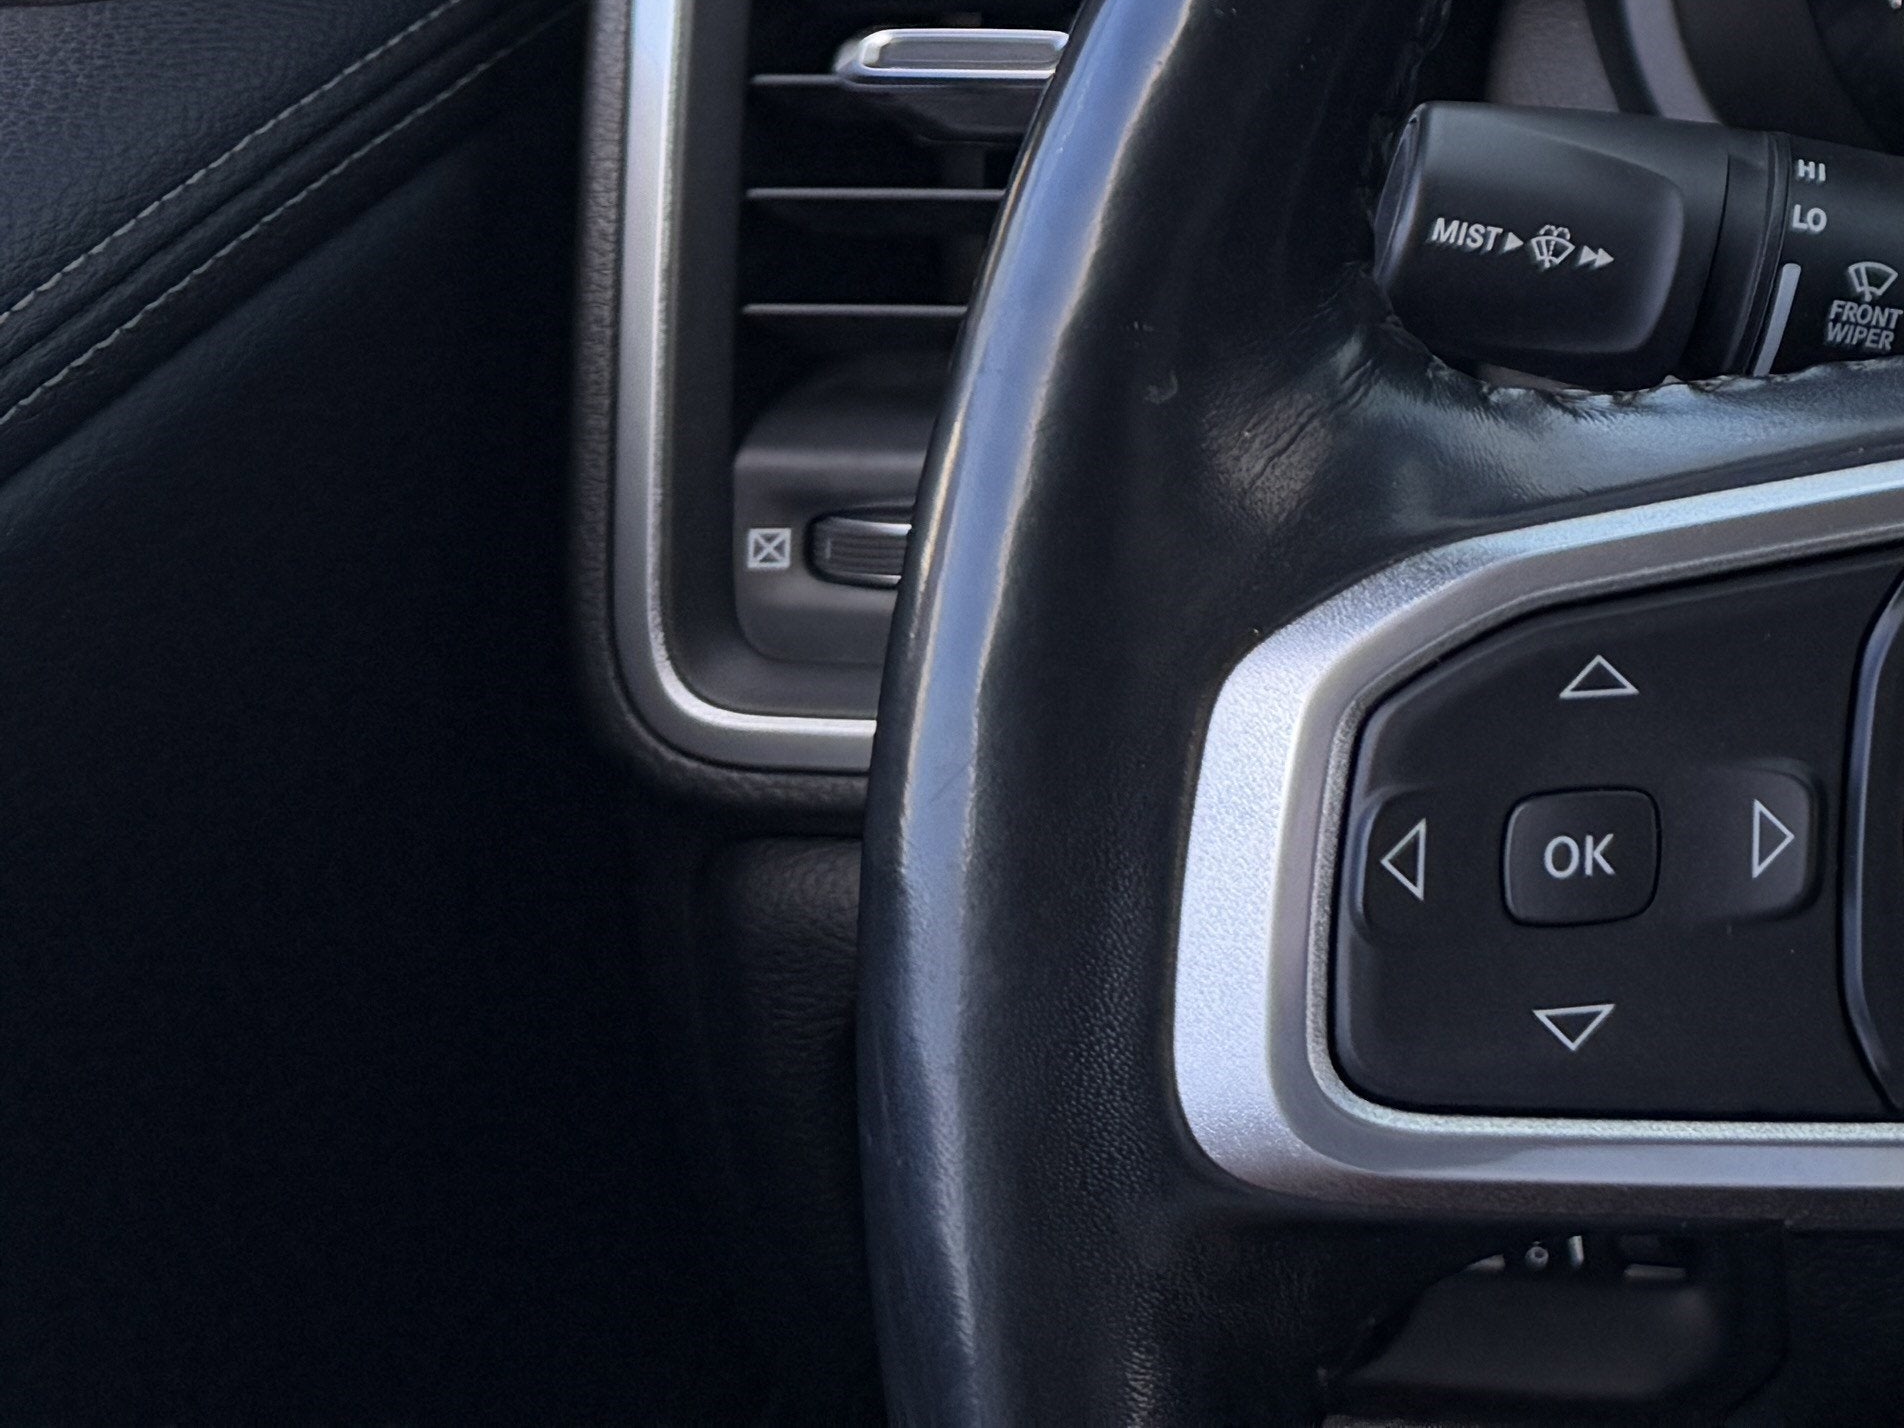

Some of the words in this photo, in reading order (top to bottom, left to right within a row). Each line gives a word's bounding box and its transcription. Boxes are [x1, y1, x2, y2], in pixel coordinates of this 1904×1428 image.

[1797, 159, 1827, 183] HI
[1791, 205, 1828, 234] LO
[1431, 216, 1503, 256] MIST
[1828, 298, 1904, 330] FRONT
[1825, 319, 1897, 351] WIPER
[1543, 833, 1617, 879] OK
